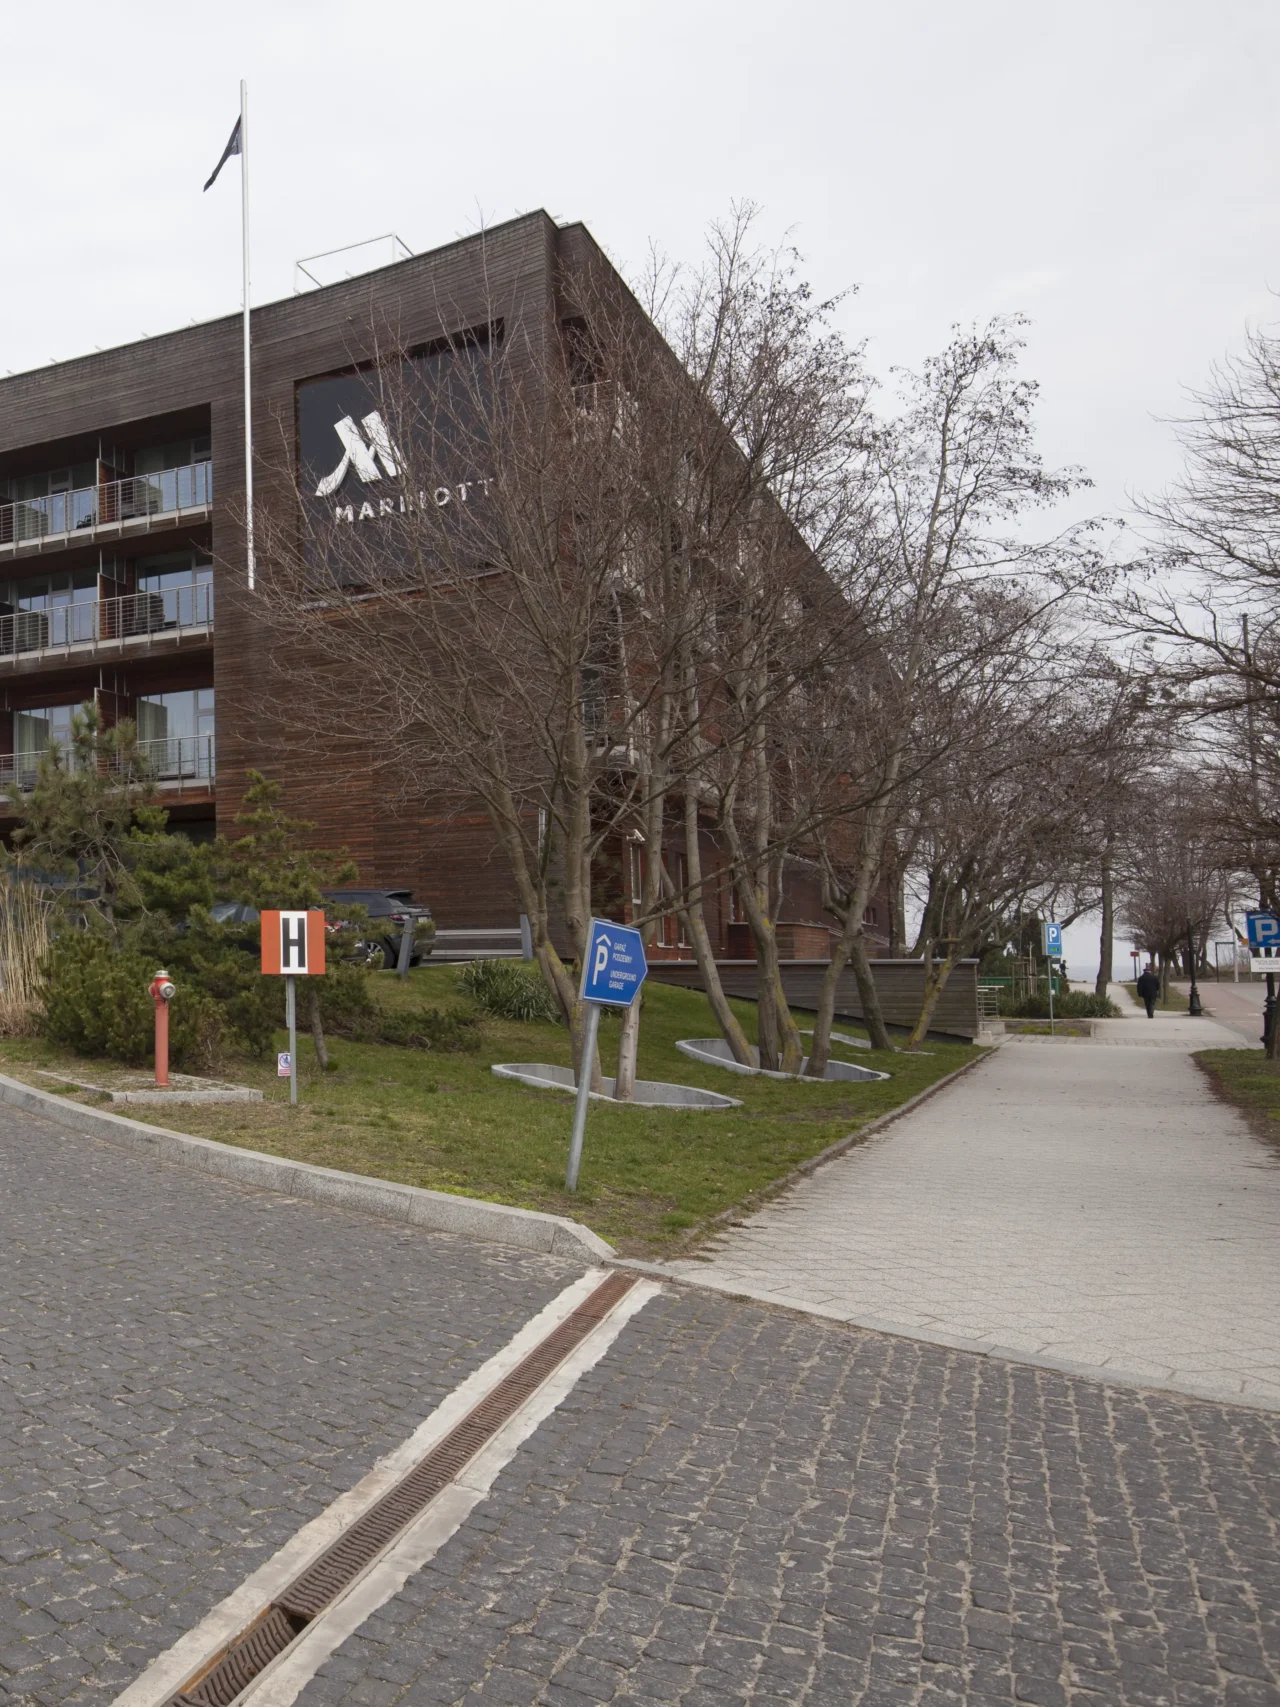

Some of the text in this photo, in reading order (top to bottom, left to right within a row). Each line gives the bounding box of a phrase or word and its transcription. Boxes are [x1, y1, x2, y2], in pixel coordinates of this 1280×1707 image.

[282, 918, 305, 967] H
[1049, 927, 1058, 942] P
[1255, 919, 1278, 942] P
[593, 945, 608, 985] P
